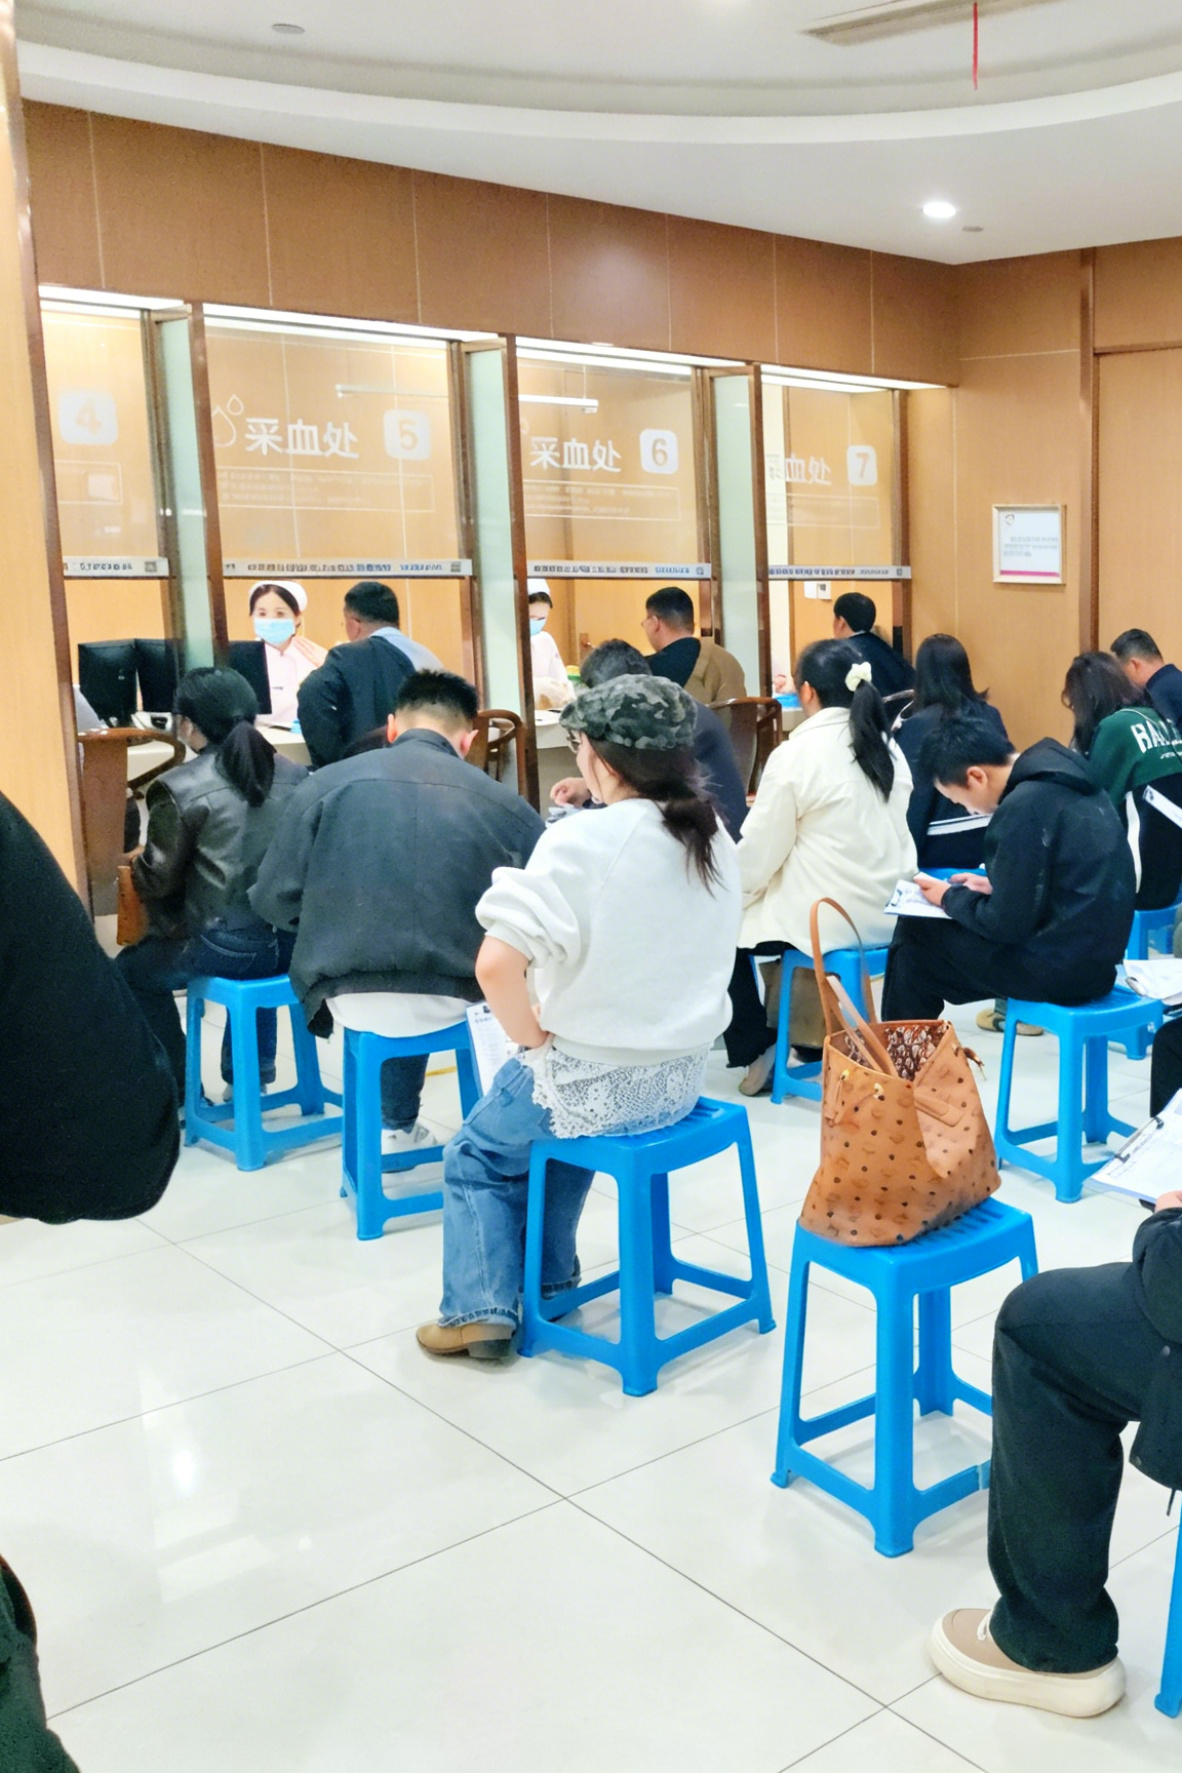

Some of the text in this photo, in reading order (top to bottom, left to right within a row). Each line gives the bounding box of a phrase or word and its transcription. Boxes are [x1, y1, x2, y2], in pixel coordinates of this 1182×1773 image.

[75, 399, 102, 435] 4
[398, 418, 418, 450] 5
[244, 417, 359, 459] 采血处
[530, 436, 622, 473] 采血处
[651, 437, 668, 467] 6
[855, 452, 869, 479] 7
